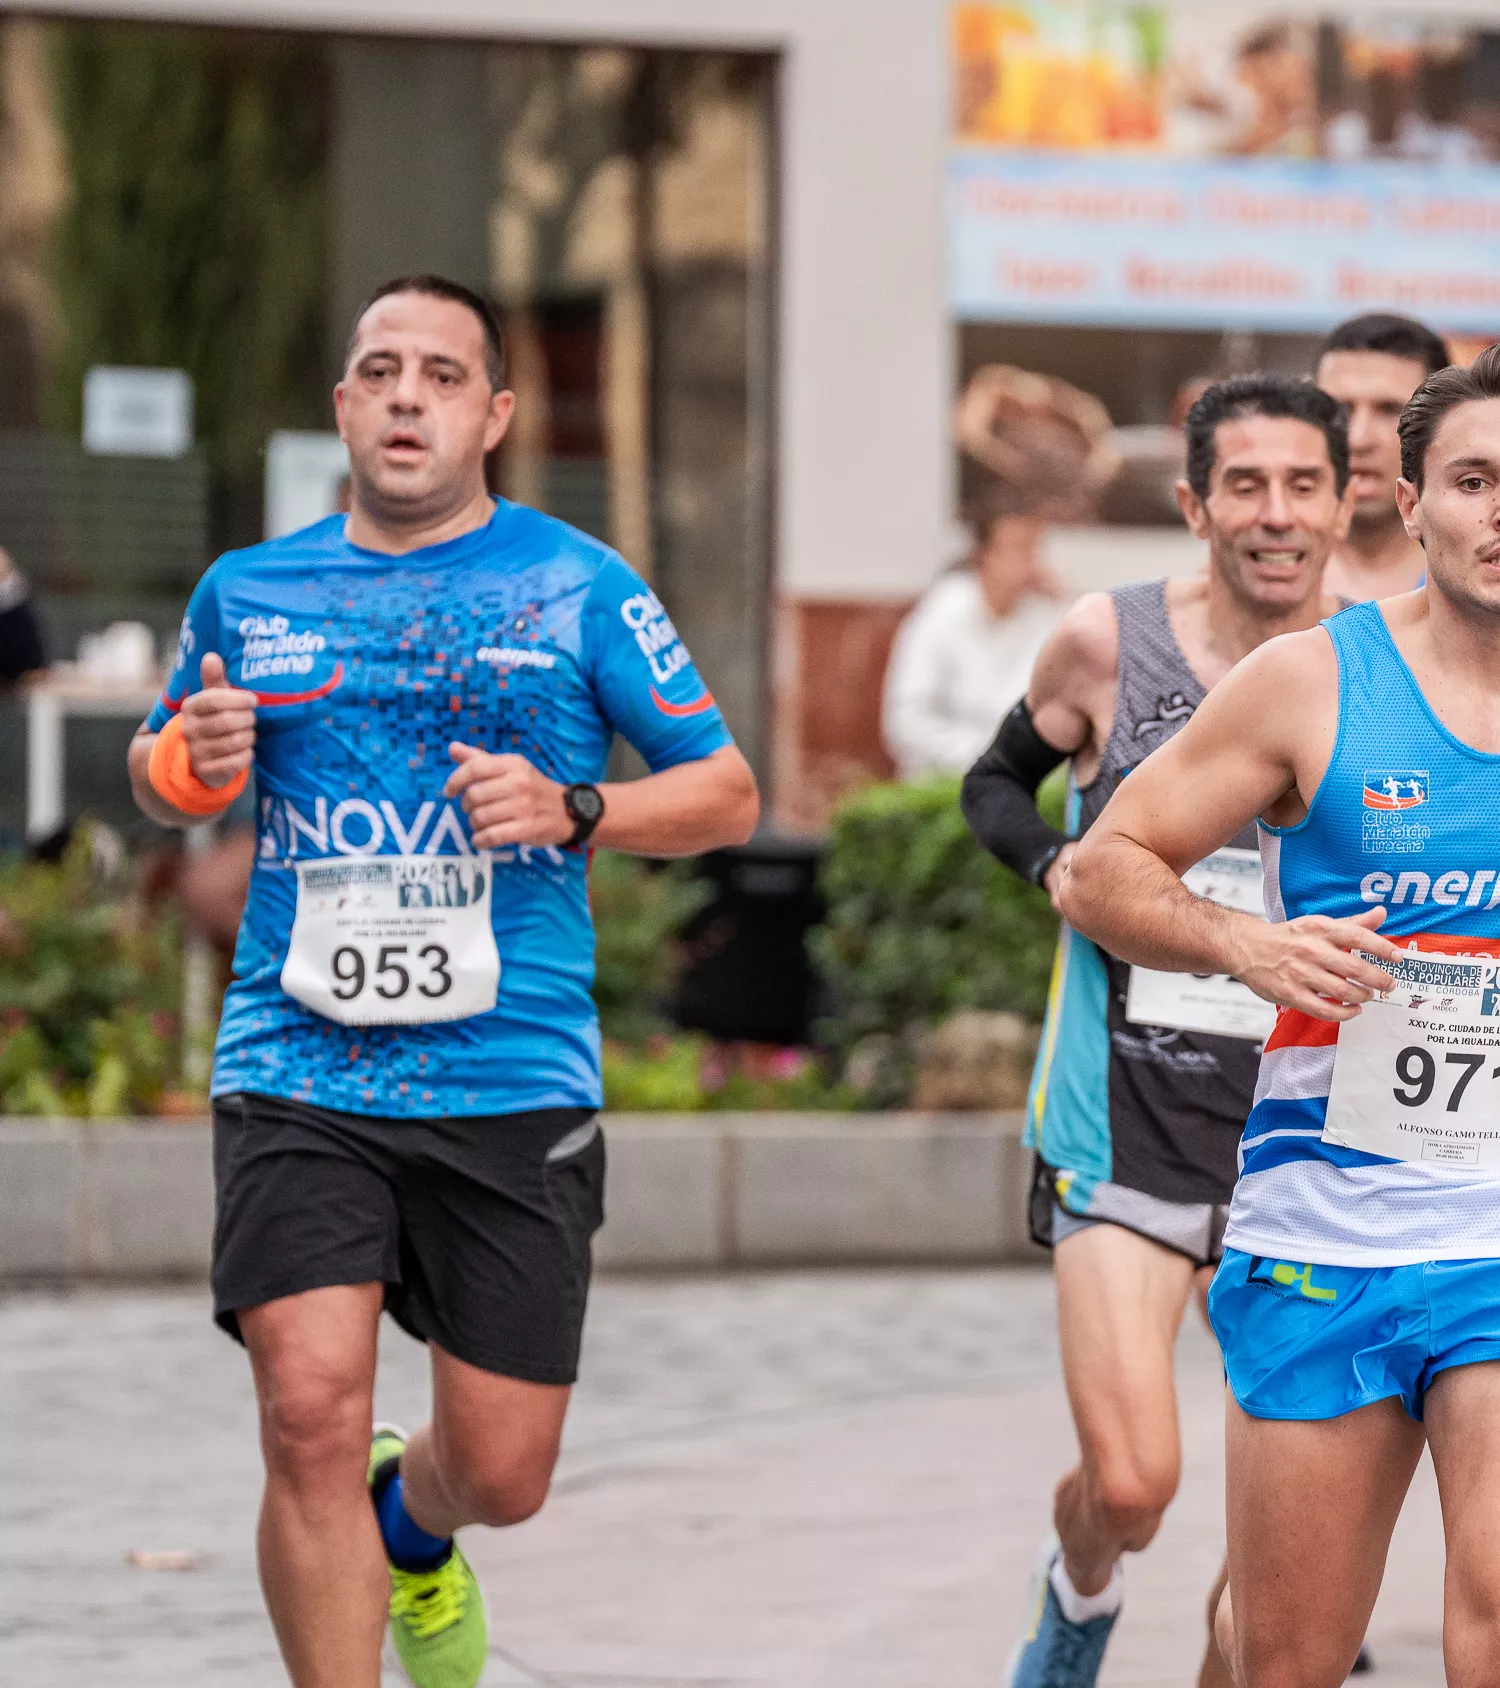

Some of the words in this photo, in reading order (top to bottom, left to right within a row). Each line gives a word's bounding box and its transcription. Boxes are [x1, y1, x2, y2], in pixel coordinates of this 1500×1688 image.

[238, 614, 290, 638] Club
[241, 654, 314, 681] Lucena
[1362, 810, 1402, 826] Club
[1363, 822, 1431, 840] Maratón
[1362, 840, 1424, 853] Lucena
[332, 943, 453, 1000] 953
[1408, 960, 1466, 976] PROVINCIAL
[1470, 966, 1482, 976] DE
[1419, 973, 1480, 988] POPULARES
[1436, 984, 1480, 996] CÓRDOBA
[1408, 1019, 1429, 1029] XXV
[1430, 1023, 1446, 1032] C.P.
[1448, 1024, 1481, 1033] CIUDAD
[1483, 1026, 1494, 1034] DE
[1427, 1035, 1445, 1044] POR
[1397, 1122, 1443, 1136] ALFONSO
[1445, 1130, 1476, 1139] GAMO
